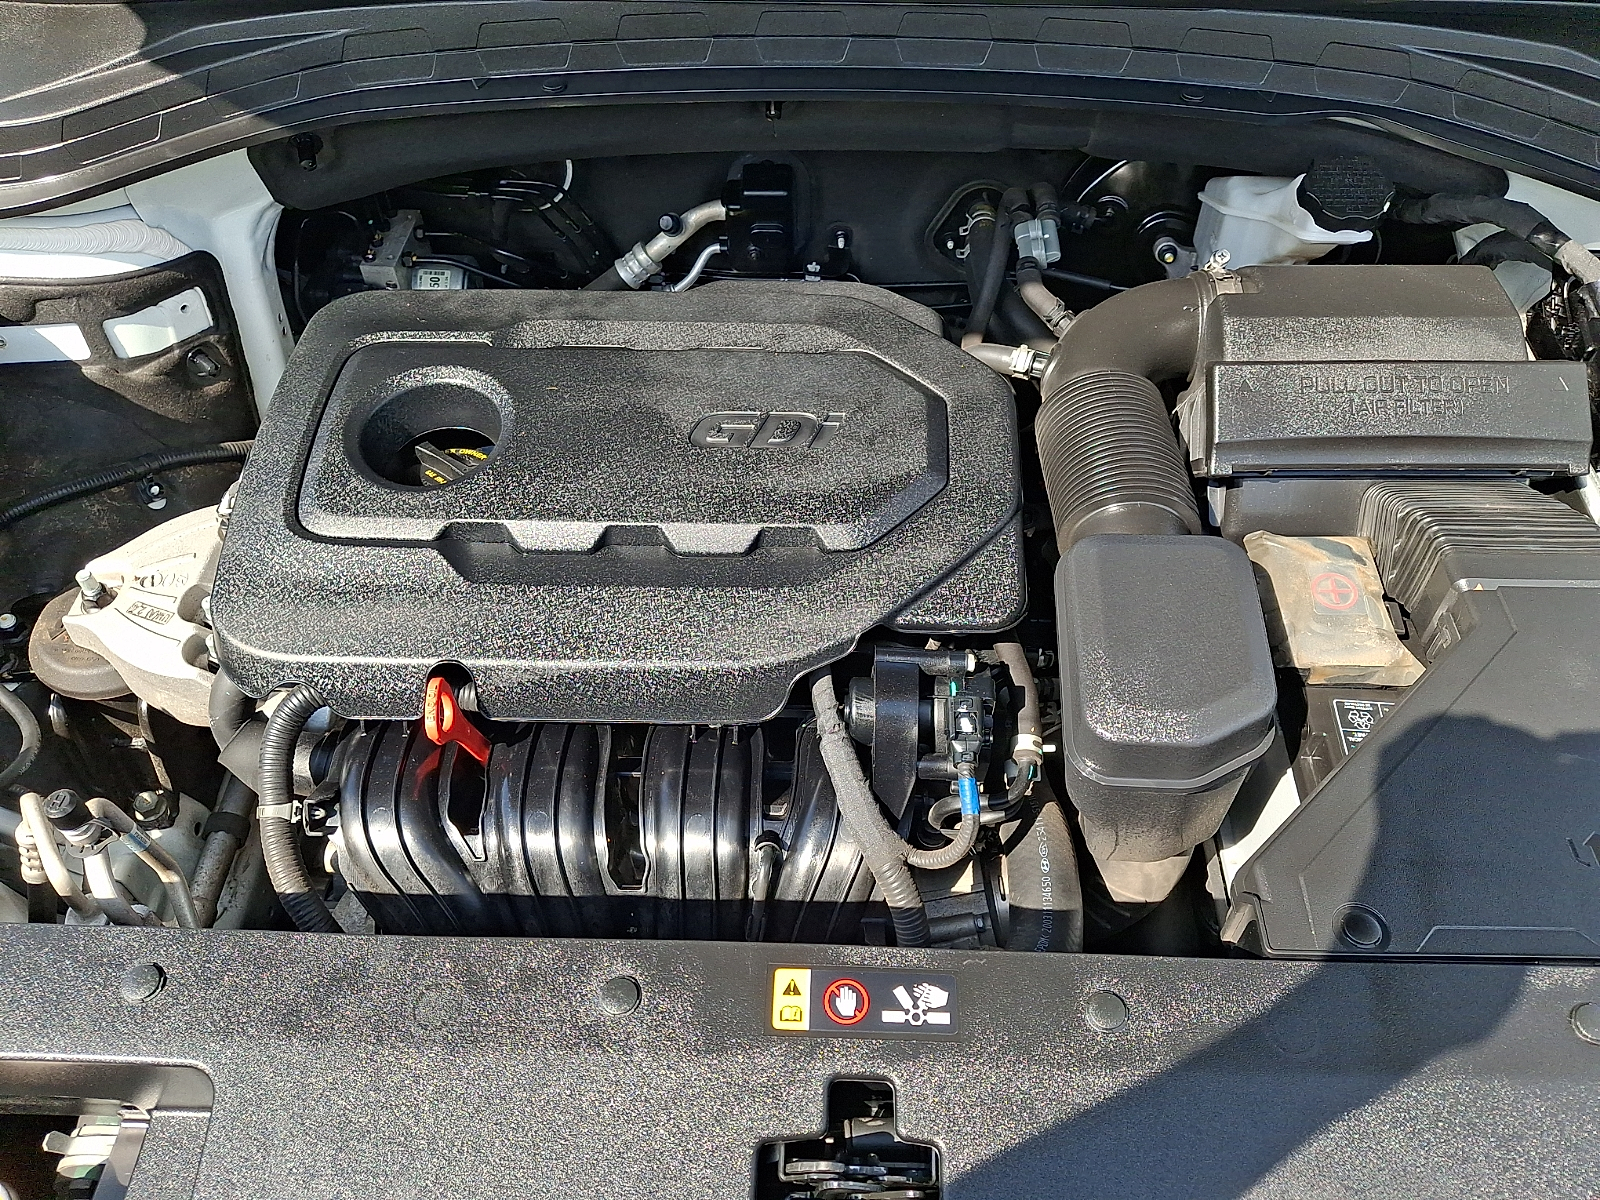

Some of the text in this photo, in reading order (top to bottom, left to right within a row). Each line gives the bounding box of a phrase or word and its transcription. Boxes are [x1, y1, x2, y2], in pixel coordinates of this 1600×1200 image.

[1300, 376, 1511, 394] PULL OUT TO OPEN
[688, 411, 846, 449] GDi
